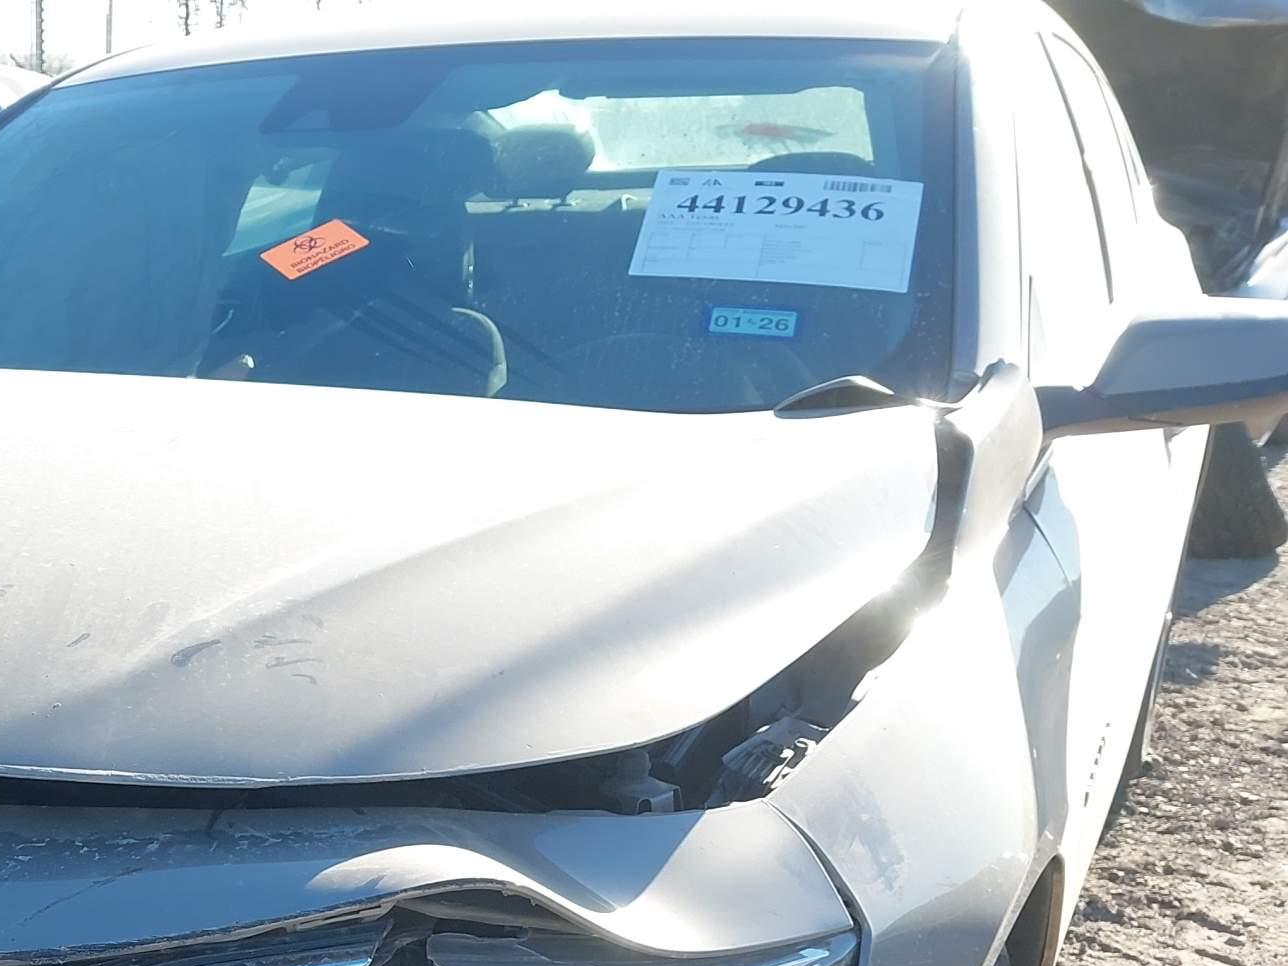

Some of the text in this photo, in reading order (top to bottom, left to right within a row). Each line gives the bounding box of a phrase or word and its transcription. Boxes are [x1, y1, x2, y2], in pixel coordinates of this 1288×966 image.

[677, 194, 885, 222] 44129436
[290, 239, 349, 268] BIOHAZARD
[713, 314, 790, 331] 01 26
